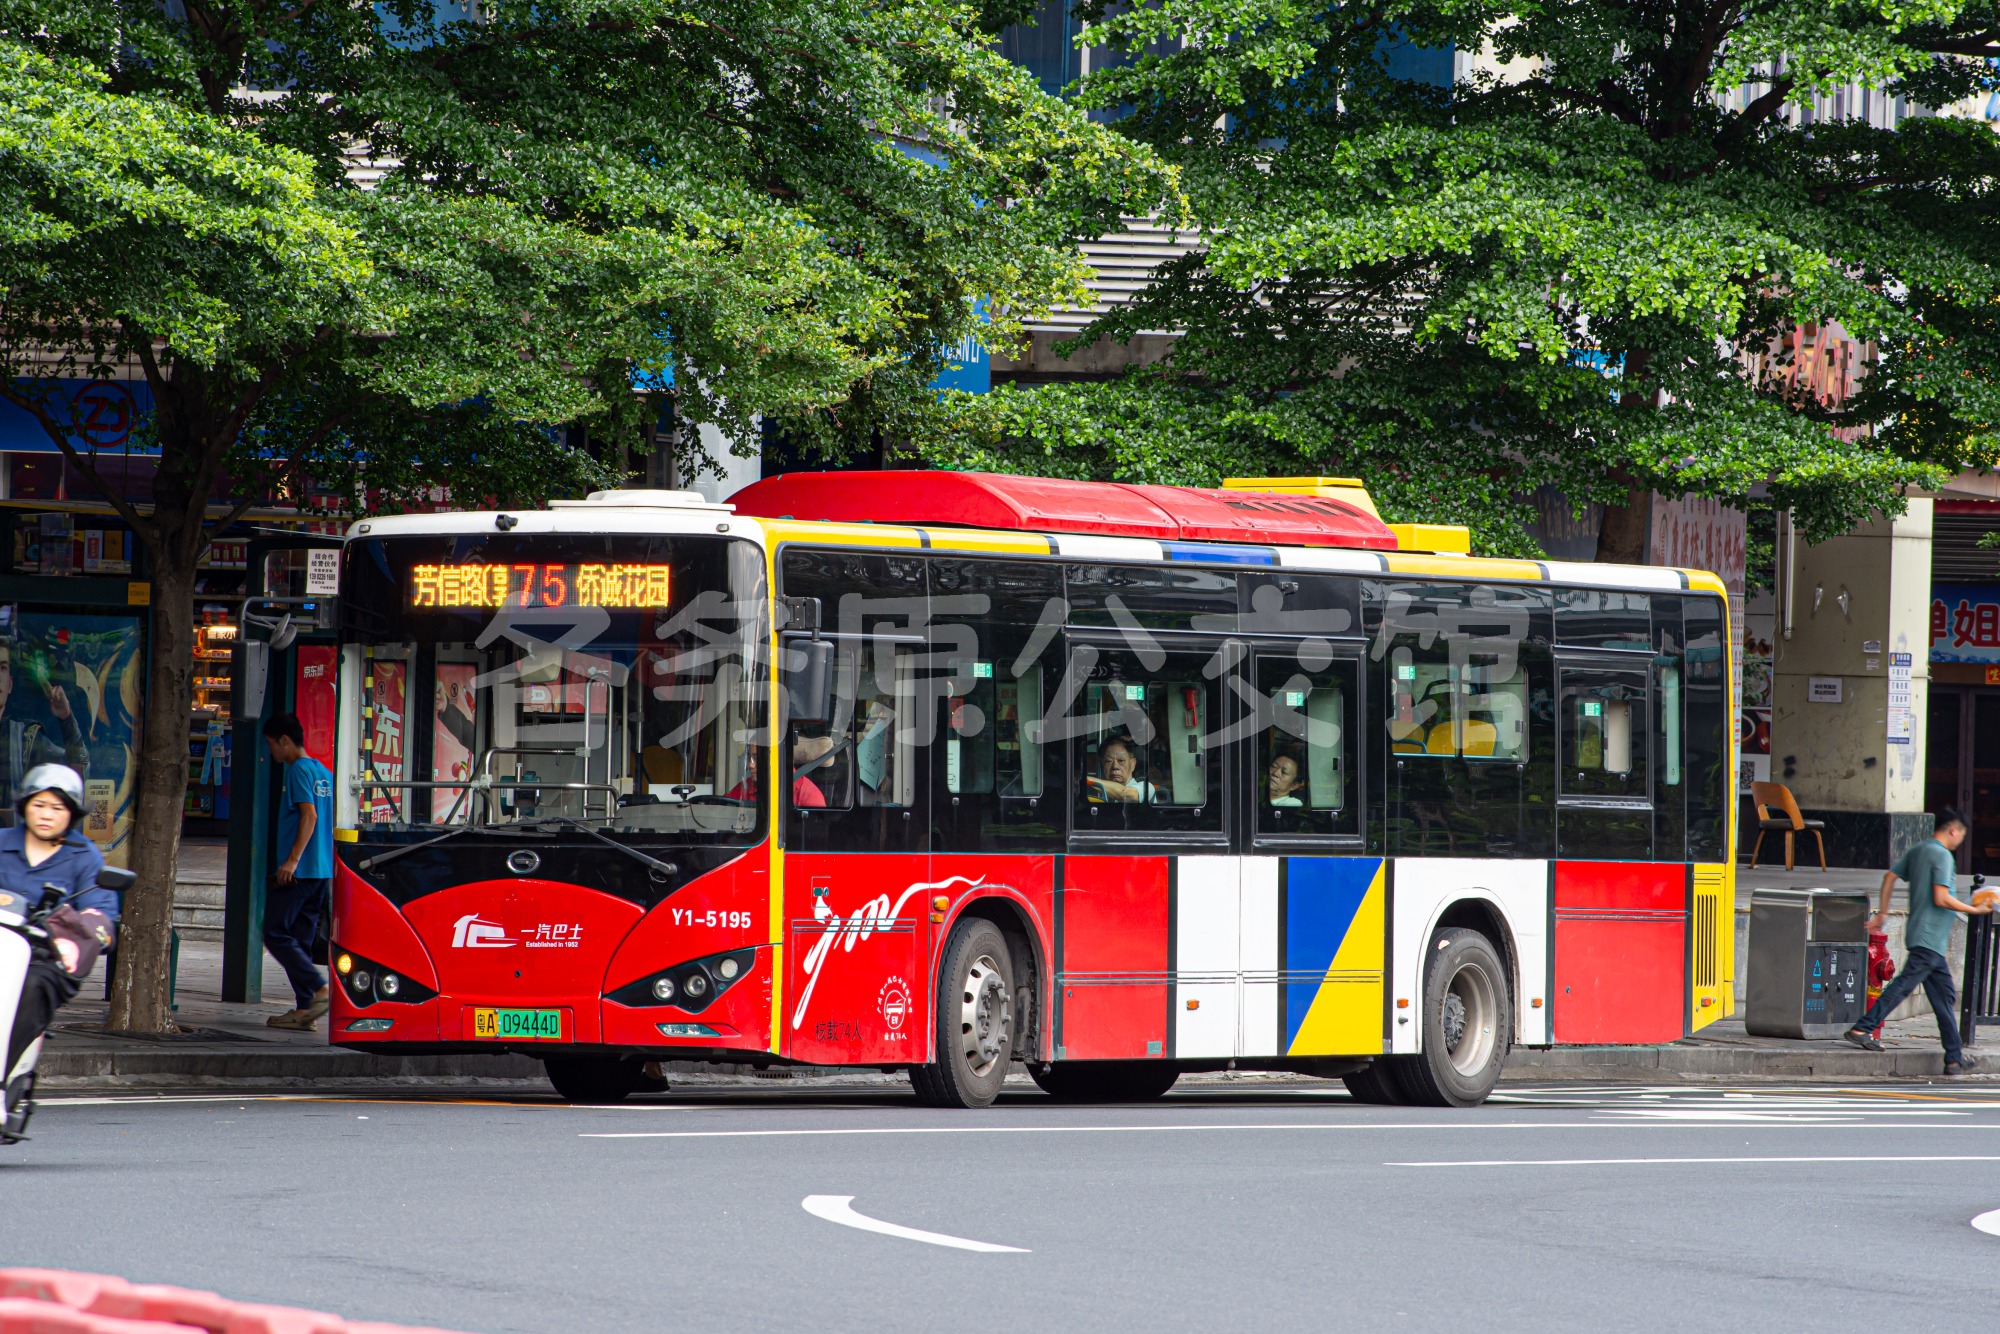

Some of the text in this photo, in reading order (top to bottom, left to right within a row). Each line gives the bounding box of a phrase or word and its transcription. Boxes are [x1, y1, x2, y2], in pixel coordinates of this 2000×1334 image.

[513, 564, 566, 607] 75
[577, 564, 670, 607] 侨诚花园
[672, 908, 752, 929] Y1-5195
[520, 923, 584, 940] 一汽巴士
